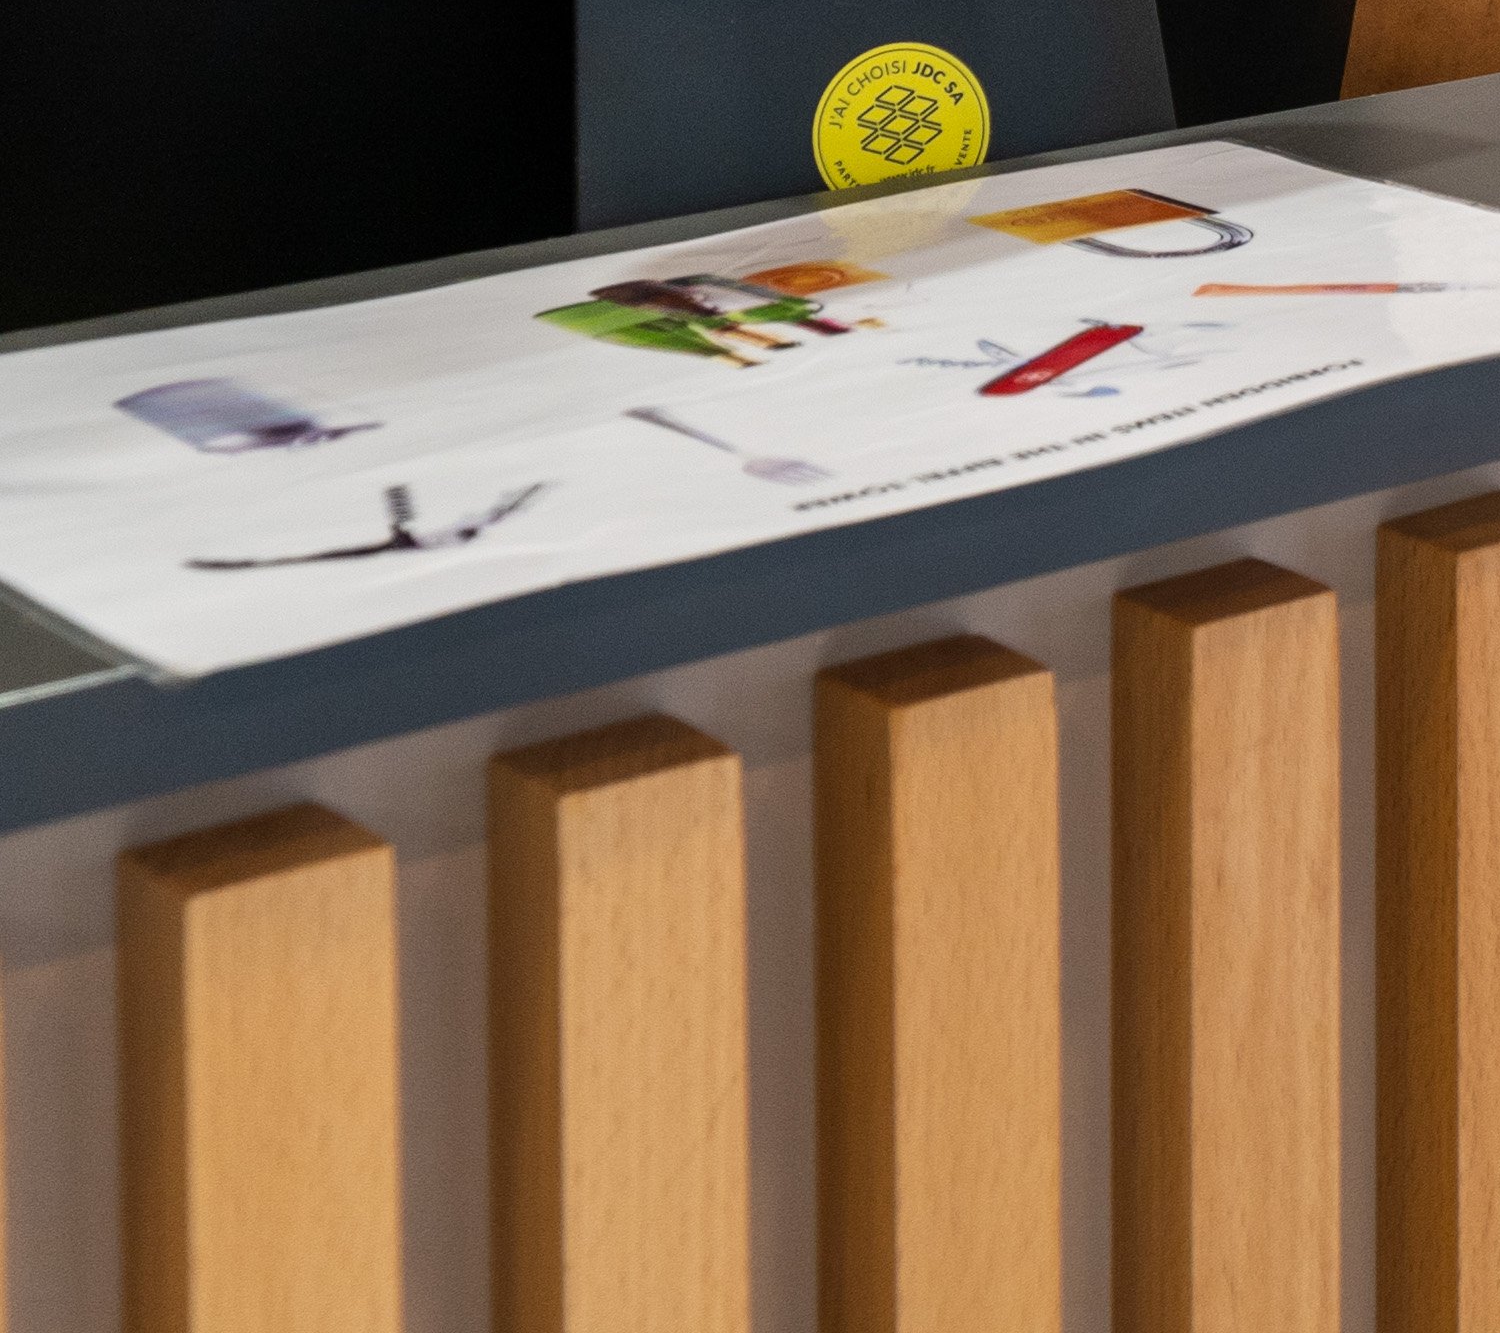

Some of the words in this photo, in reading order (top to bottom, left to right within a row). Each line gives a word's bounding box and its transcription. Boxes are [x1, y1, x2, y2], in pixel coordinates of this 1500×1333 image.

[829, 99, 850, 129] J'AI
[847, 60, 907, 96] CHOISI
[912, 61, 946, 85] JDC
[944, 81, 964, 106] SA
[954, 129, 972, 166] VENTE
[1202, 358, 1364, 407] FORBIDDEN
[1110, 405, 1198, 434] ITEMS
[1007, 442, 1066, 461] THE
[1072, 432, 1107, 446] IN
[912, 457, 1004, 484] EIFFEL
[793, 482, 907, 512] TOWER
